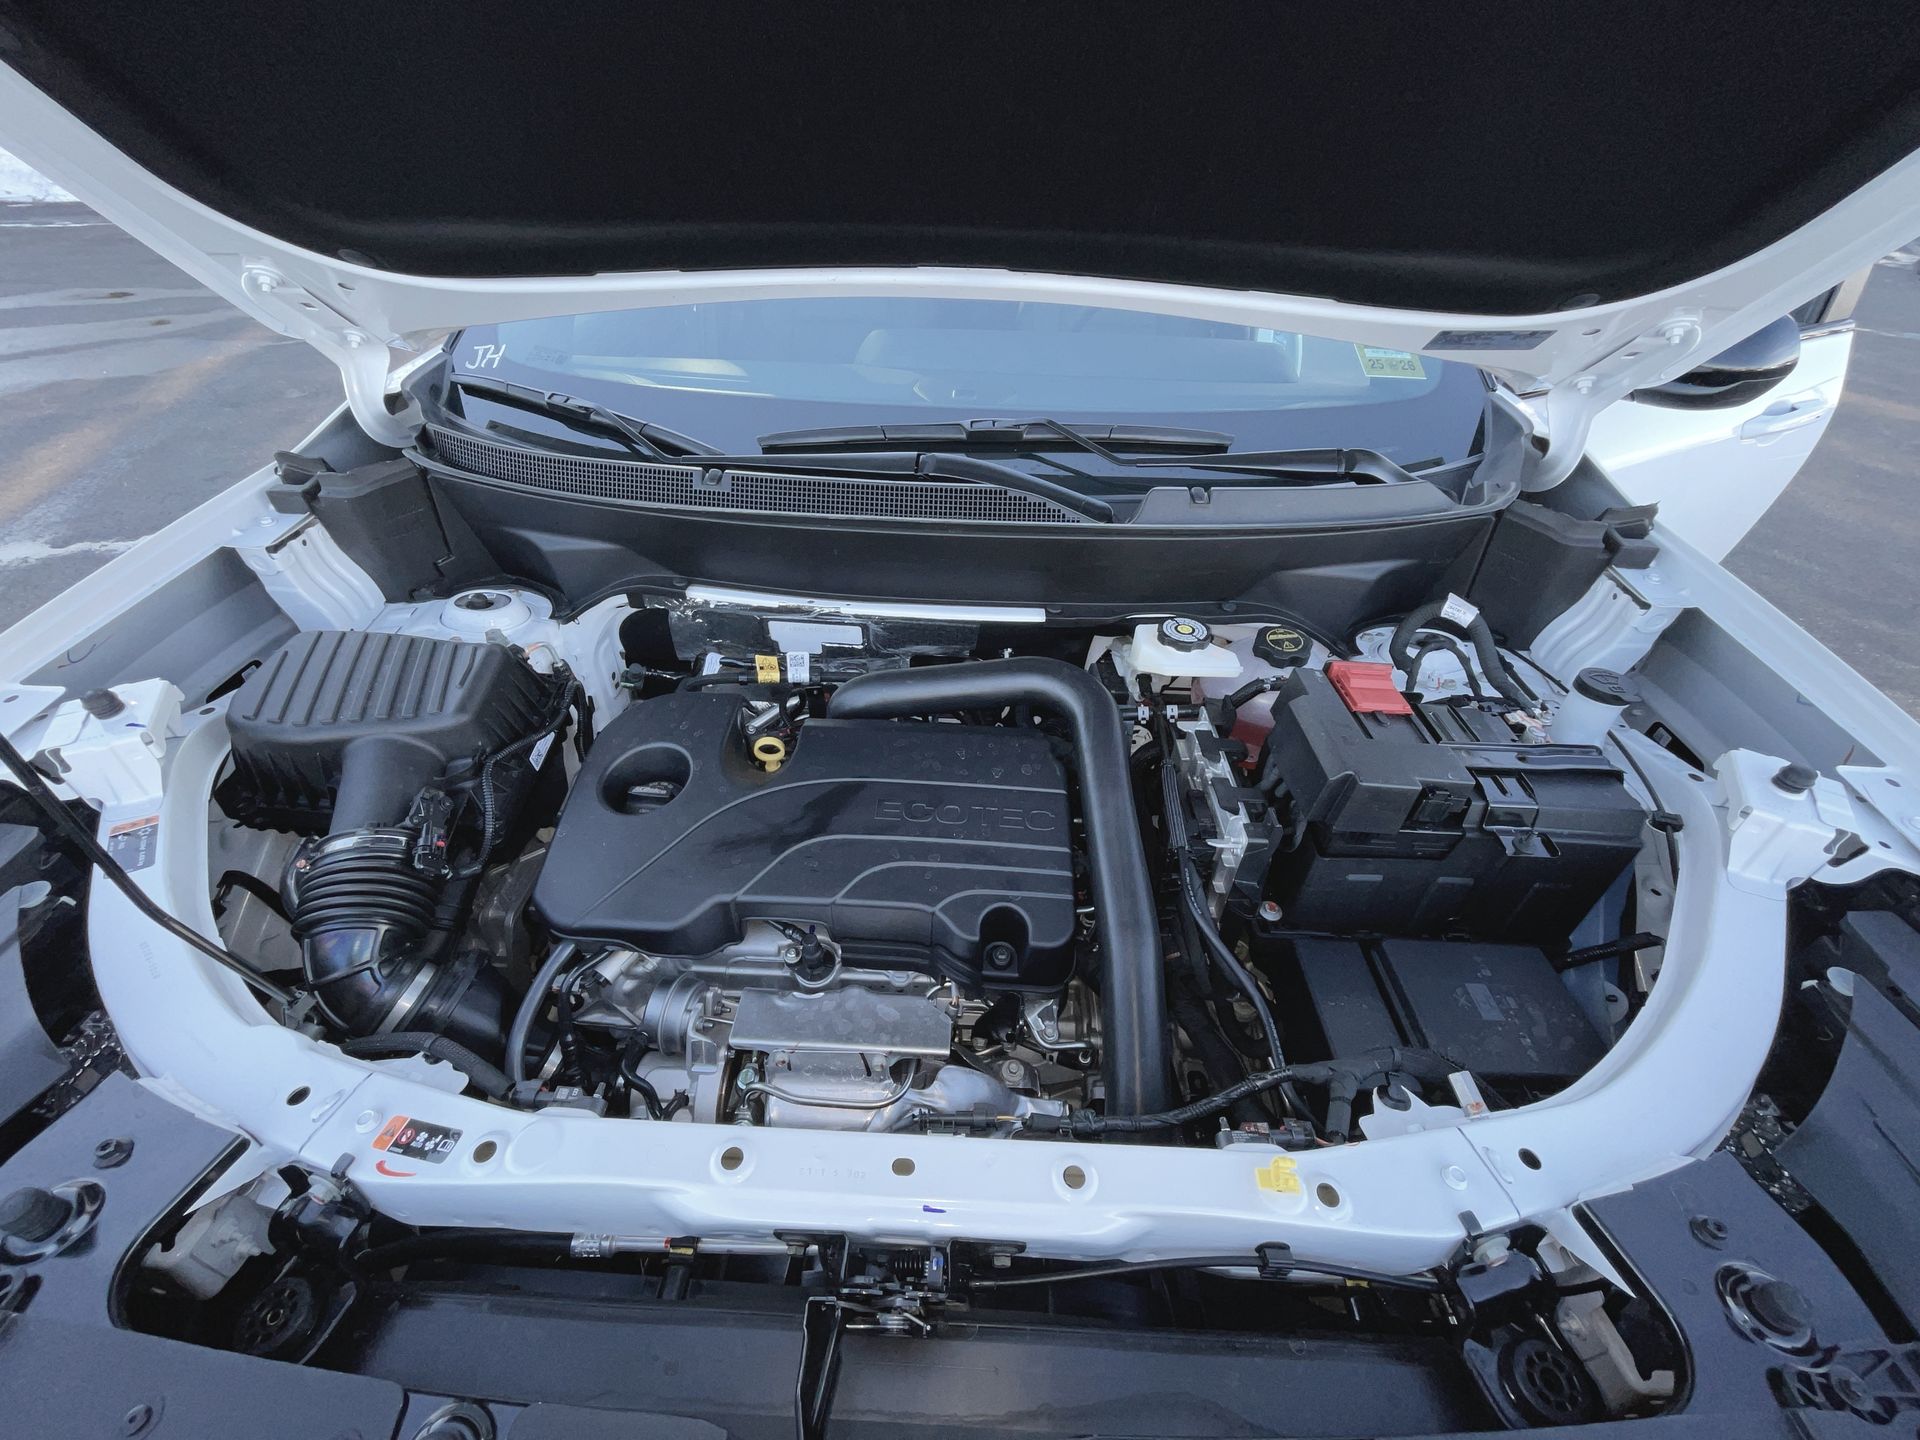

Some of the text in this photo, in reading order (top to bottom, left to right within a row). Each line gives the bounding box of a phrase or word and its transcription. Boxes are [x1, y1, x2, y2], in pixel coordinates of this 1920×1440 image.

[465, 344, 506, 369] JH
[1368, 358, 1385, 370] 25
[873, 799, 1056, 832] ECOTEC
